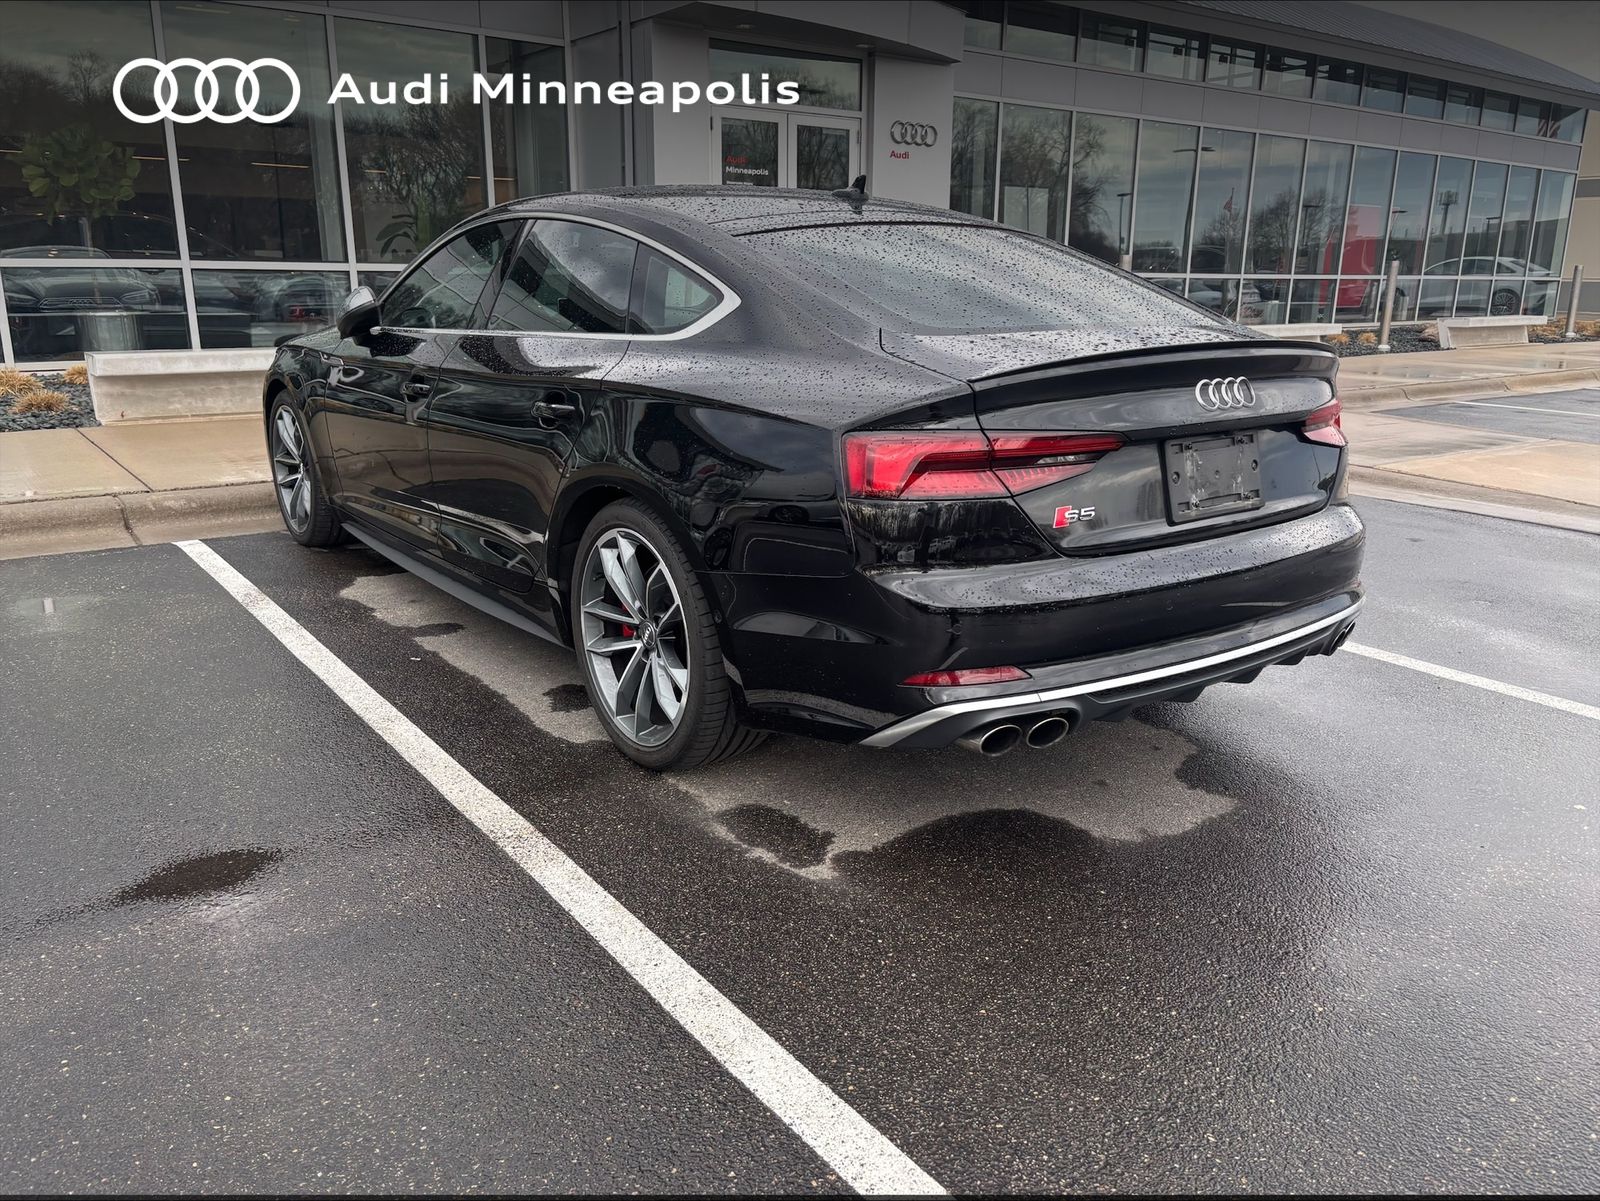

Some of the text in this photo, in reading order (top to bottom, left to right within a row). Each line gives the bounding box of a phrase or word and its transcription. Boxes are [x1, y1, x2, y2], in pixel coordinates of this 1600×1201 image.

[726, 155, 747, 164] Audi
[889, 150, 910, 160] Audi
[725, 166, 769, 176] Minneapolis
[1063, 506, 1096, 523] S5
